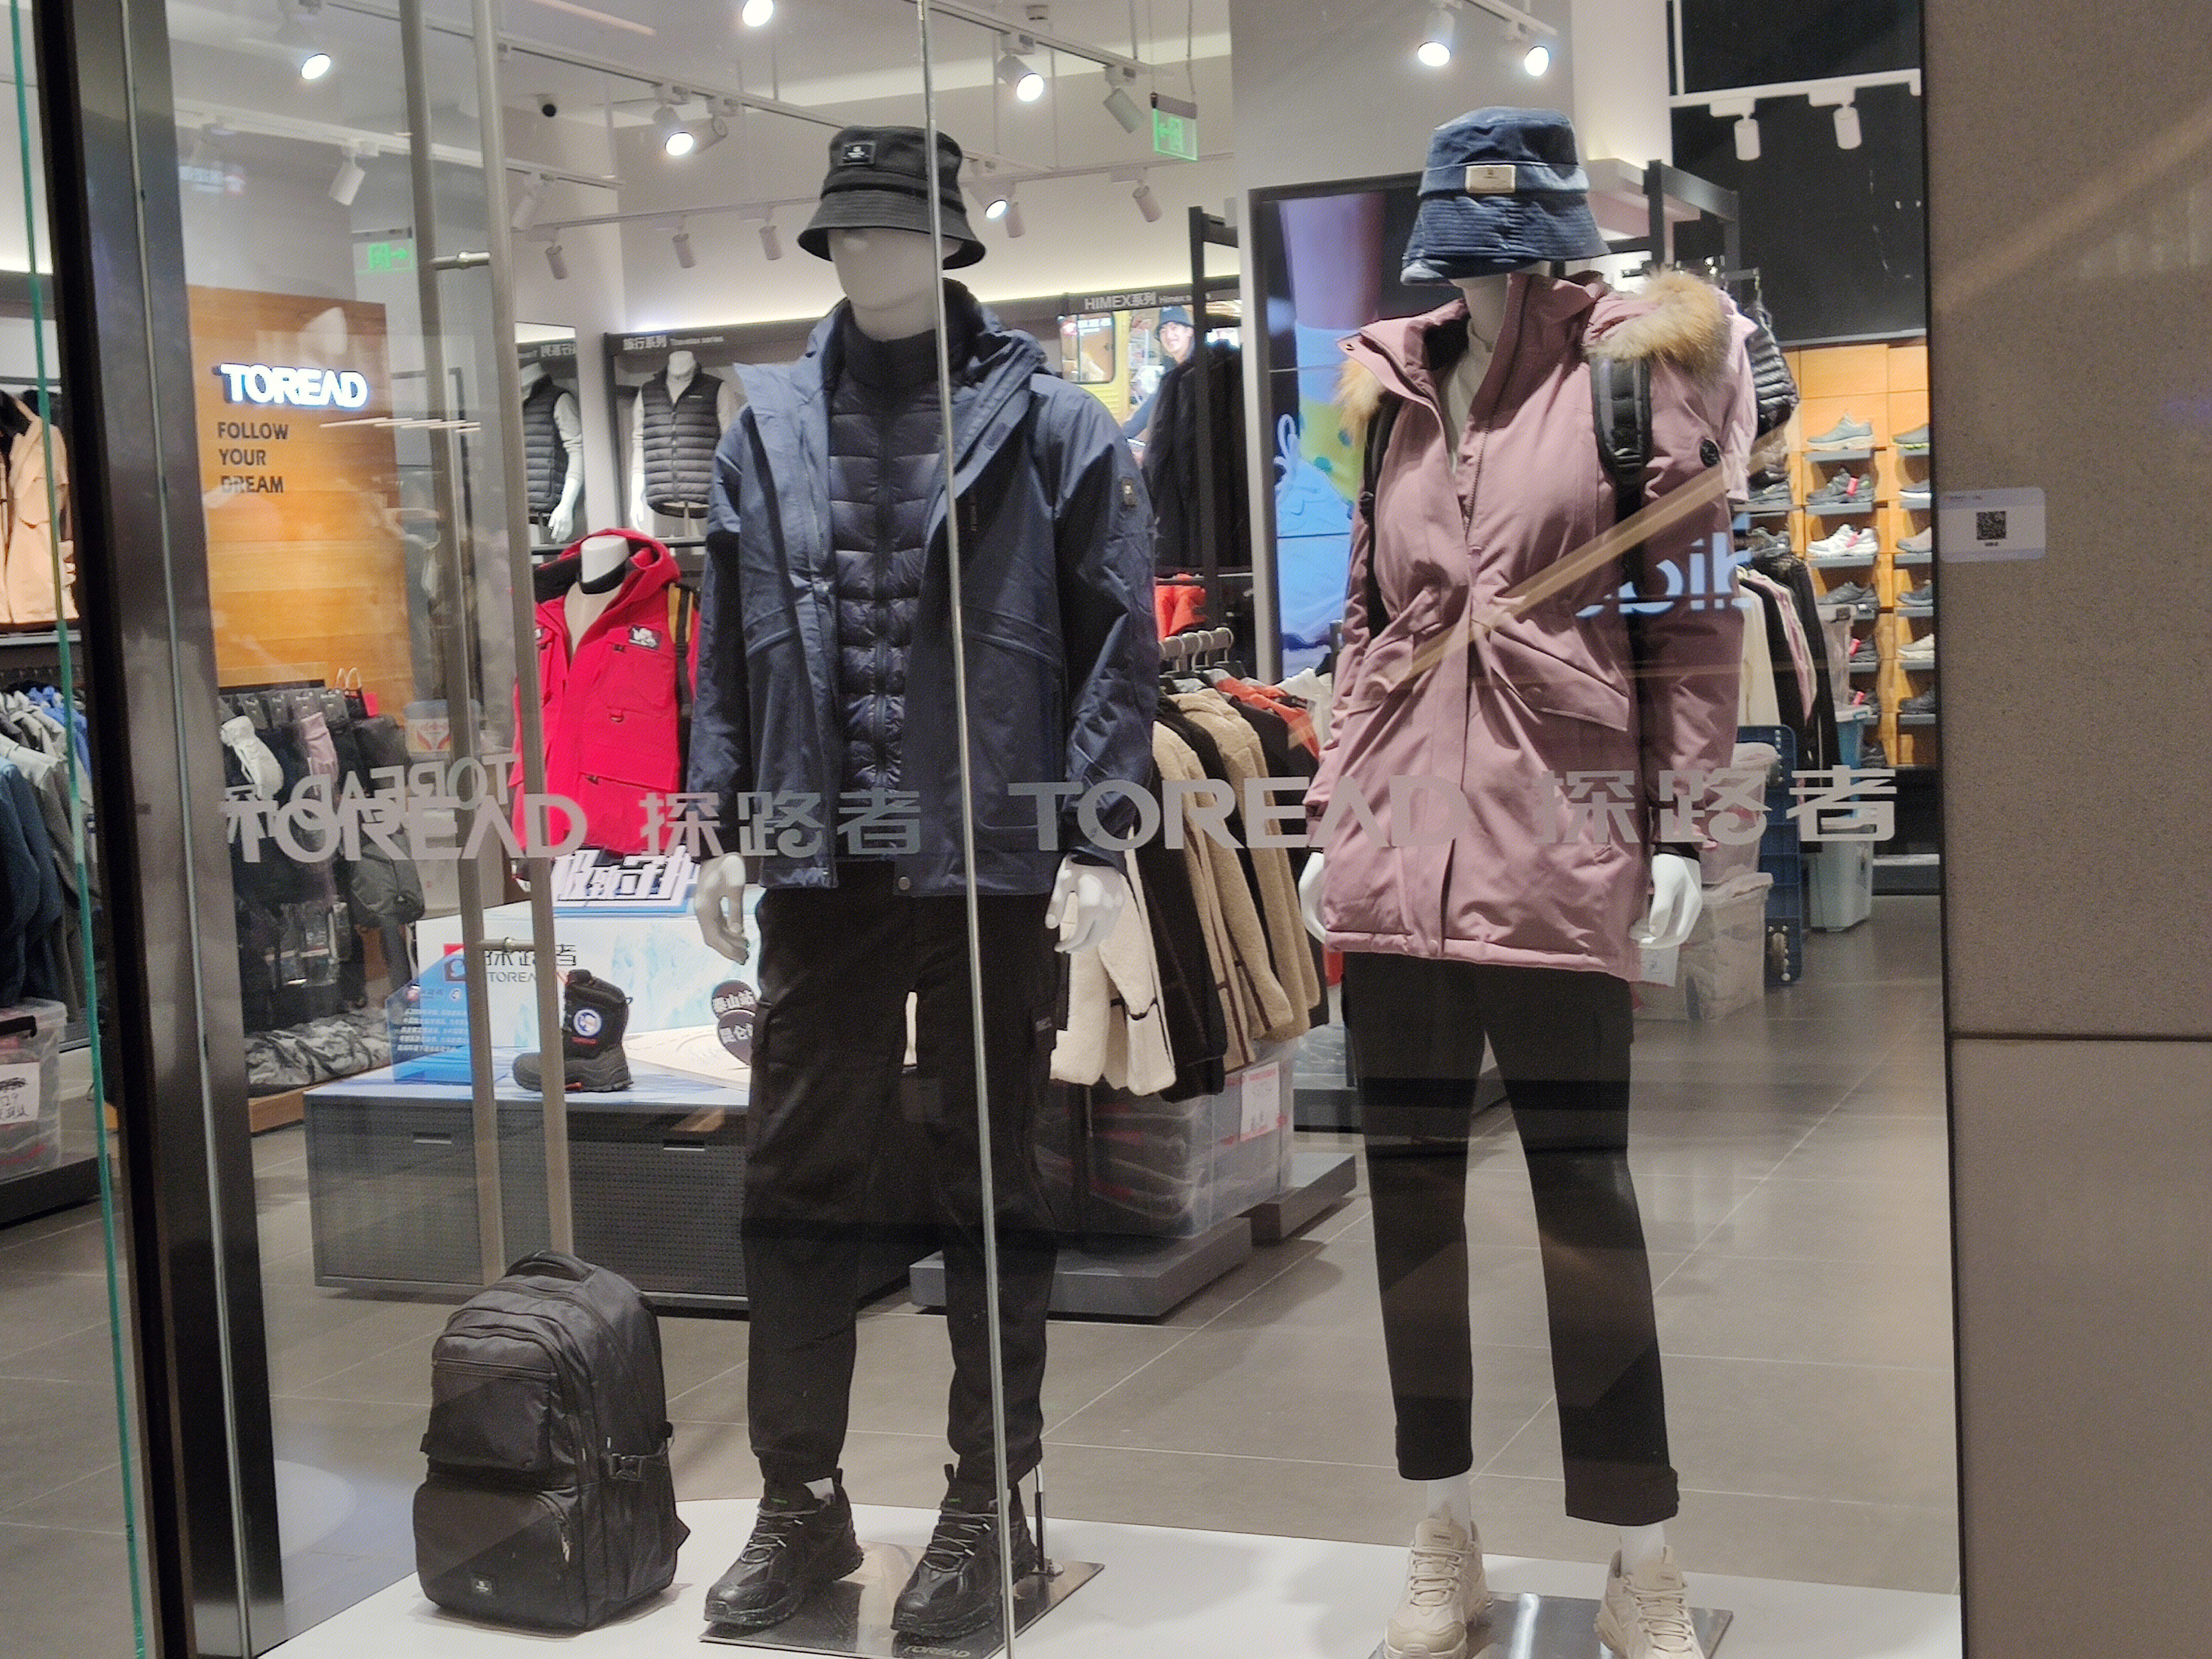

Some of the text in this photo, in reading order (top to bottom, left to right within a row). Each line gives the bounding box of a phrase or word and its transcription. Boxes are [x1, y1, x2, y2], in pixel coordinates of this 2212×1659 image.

[219, 363, 368, 409] TOREAD
[217, 421, 289, 441] FOLLOW
[218, 447, 267, 466] YOUR
[220, 474, 284, 494] DREAM
[221, 793, 588, 863] TOREAD
[638, 787, 921, 859] 探路者
[1008, 765, 1898, 852] TOREAD 探路者
